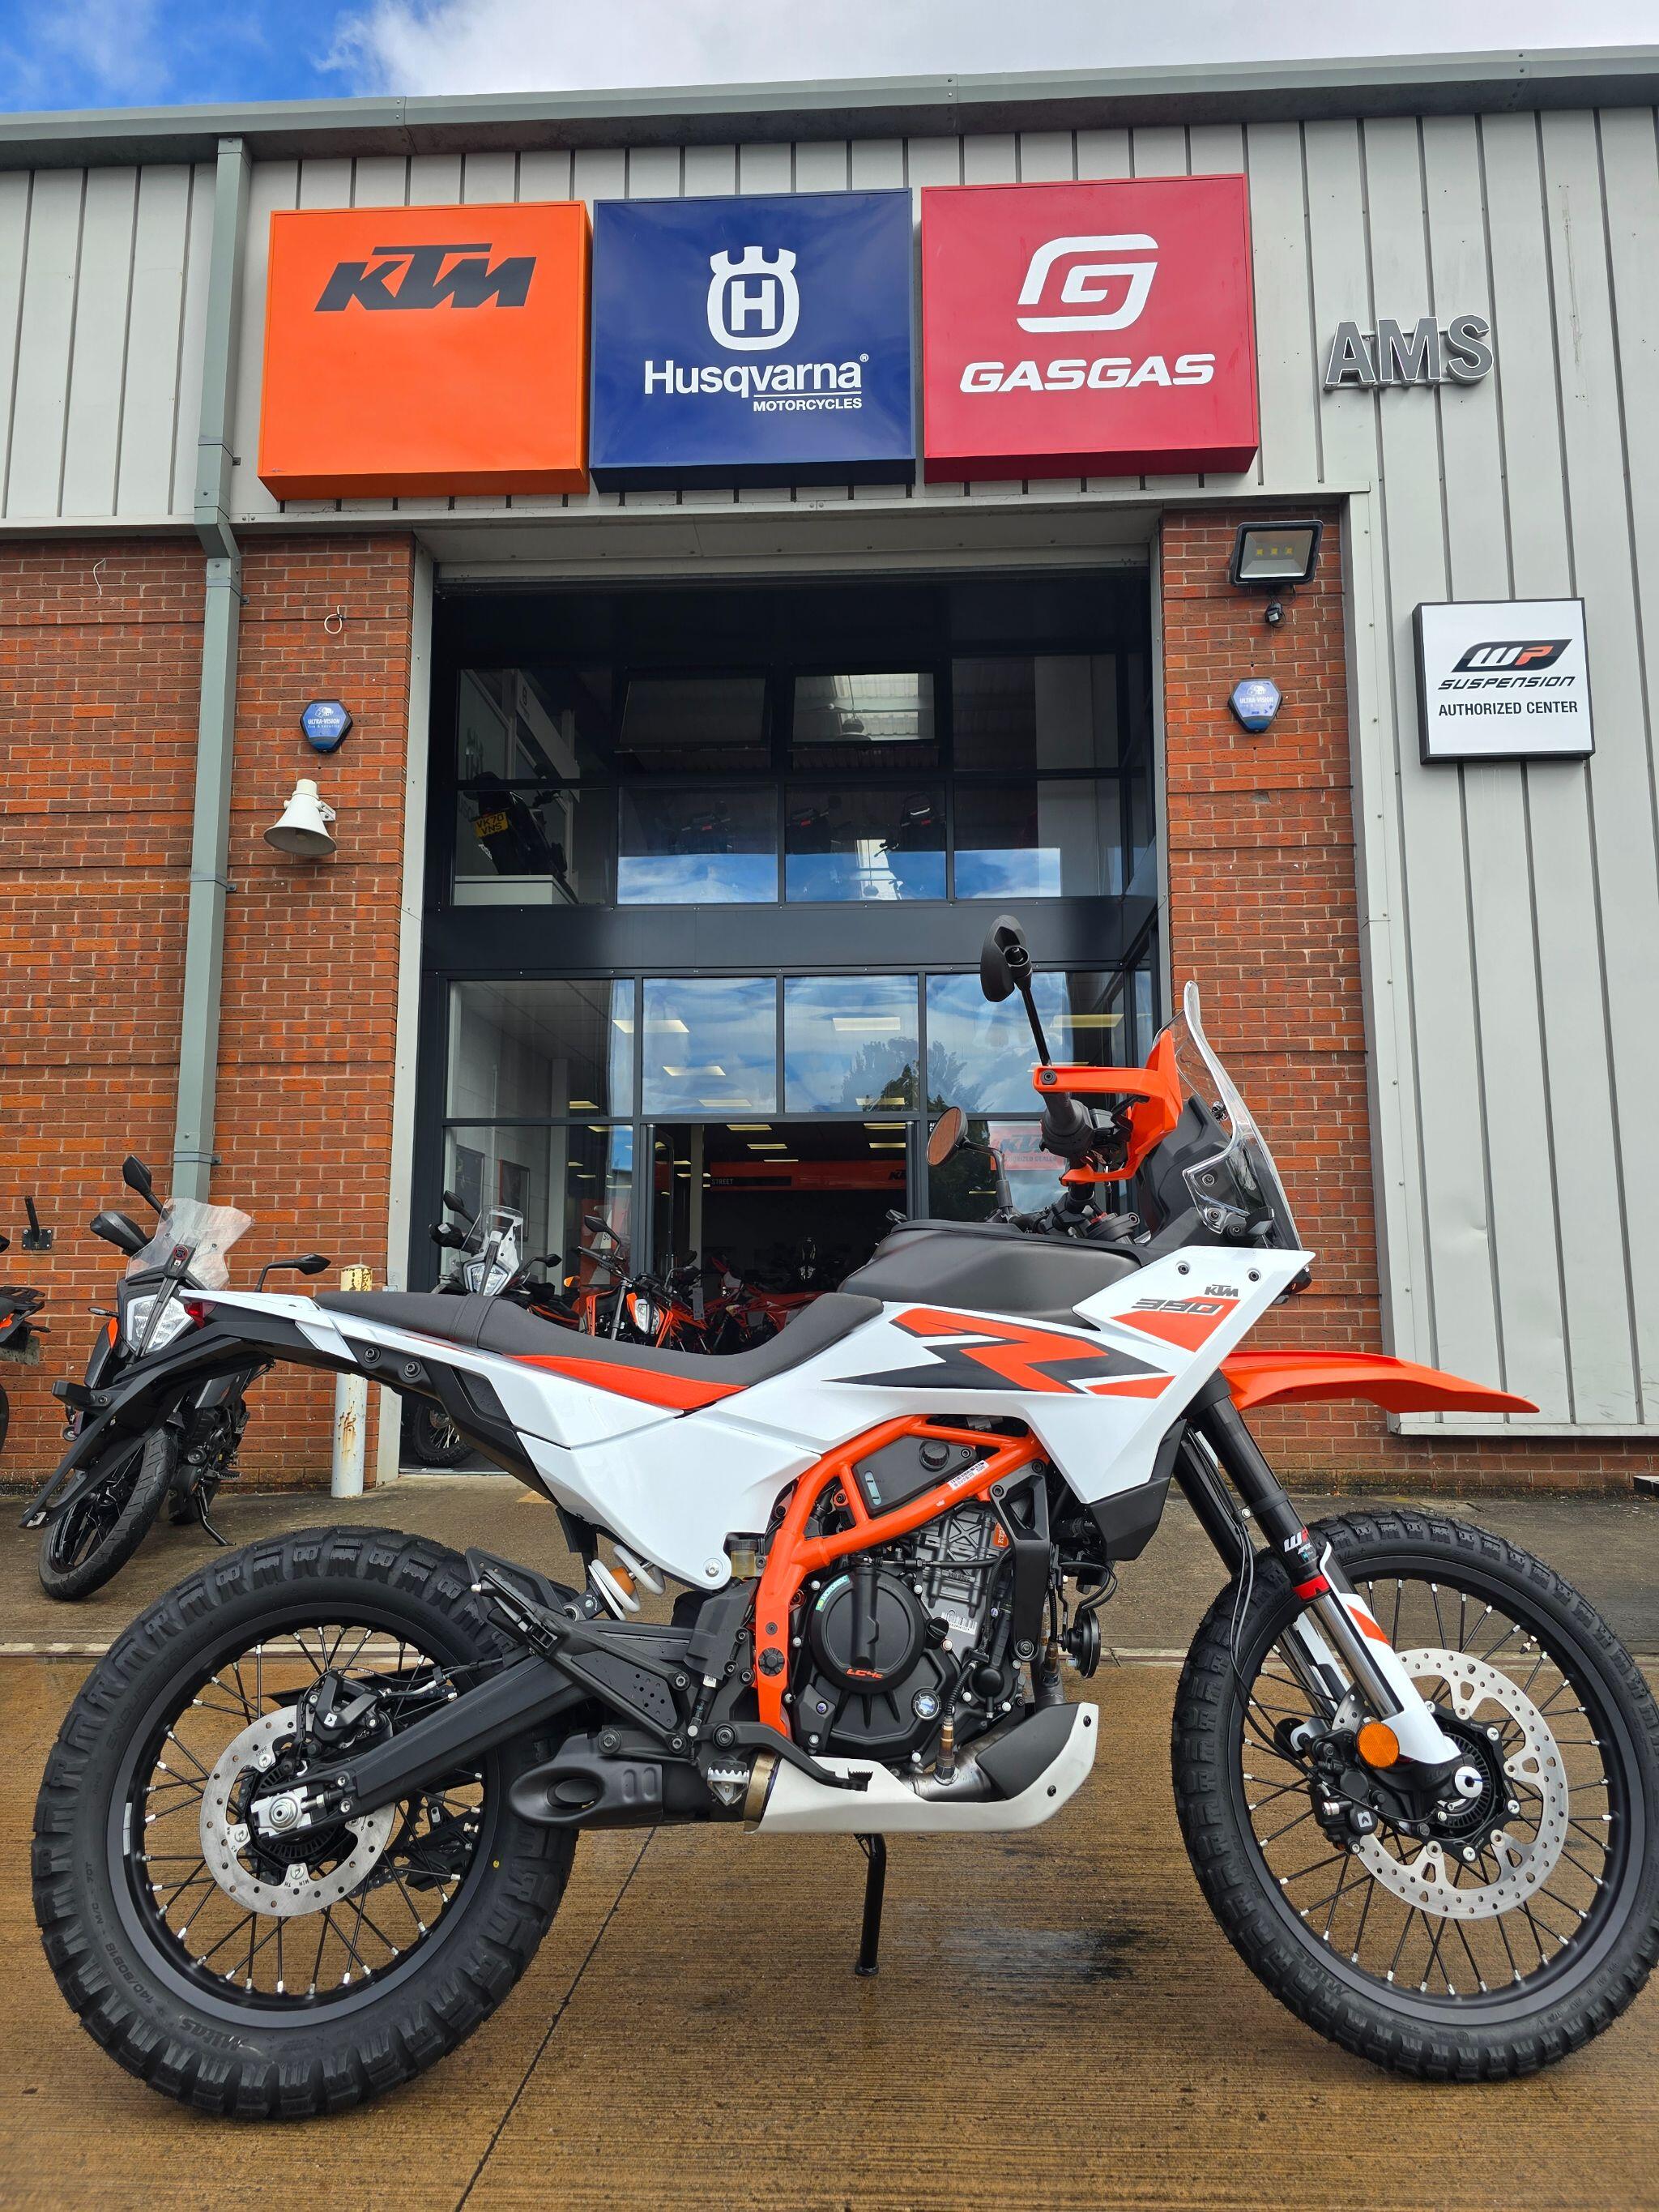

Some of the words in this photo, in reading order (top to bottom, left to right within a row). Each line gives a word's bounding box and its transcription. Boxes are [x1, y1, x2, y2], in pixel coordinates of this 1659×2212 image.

[313, 243, 537, 312] KTM
[1325, 314, 1493, 387] AMS
[959, 352, 1216, 394] GASGAS
[753, 397, 863, 412] MOTORCYCLES
[1437, 676, 1576, 690] SUSPENSION
[1438, 702, 1522, 716] AUTHORIZED
[1526, 700, 1579, 714] CENTER
[476, 813, 504, 828] VK70
[480, 822, 502, 835] VNS
[711, 1177, 734, 1185] STREET
[1205, 1284, 1239, 1297] KTM
[1131, 1298, 1223, 1314] 390
[821, 1574, 848, 1599] MOTOREX
[102, 1939, 156, 2008] 140/80B18
[179, 2011, 248, 2055] Mitas
